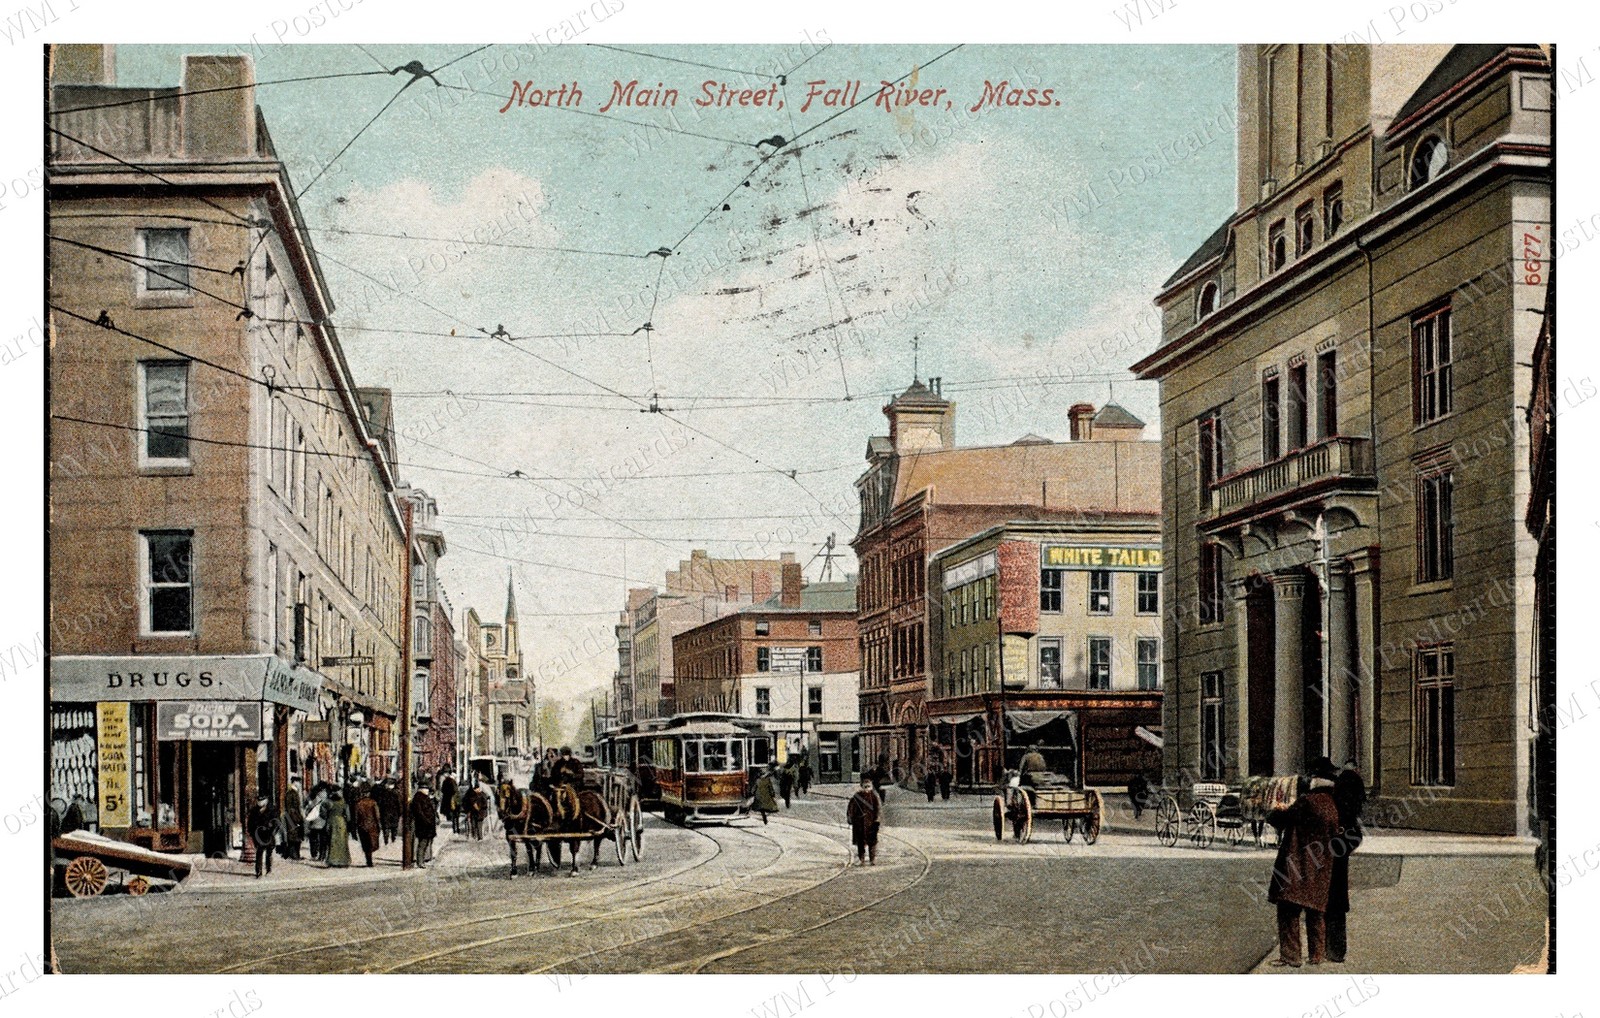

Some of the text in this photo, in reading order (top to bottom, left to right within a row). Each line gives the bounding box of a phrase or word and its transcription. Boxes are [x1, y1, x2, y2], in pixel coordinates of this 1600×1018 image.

[500, 80, 1061, 113] North Main Street, Fall River, Mass.
[1049, 547, 1102, 565] WHITE
[174, 714, 239, 729] SODA
